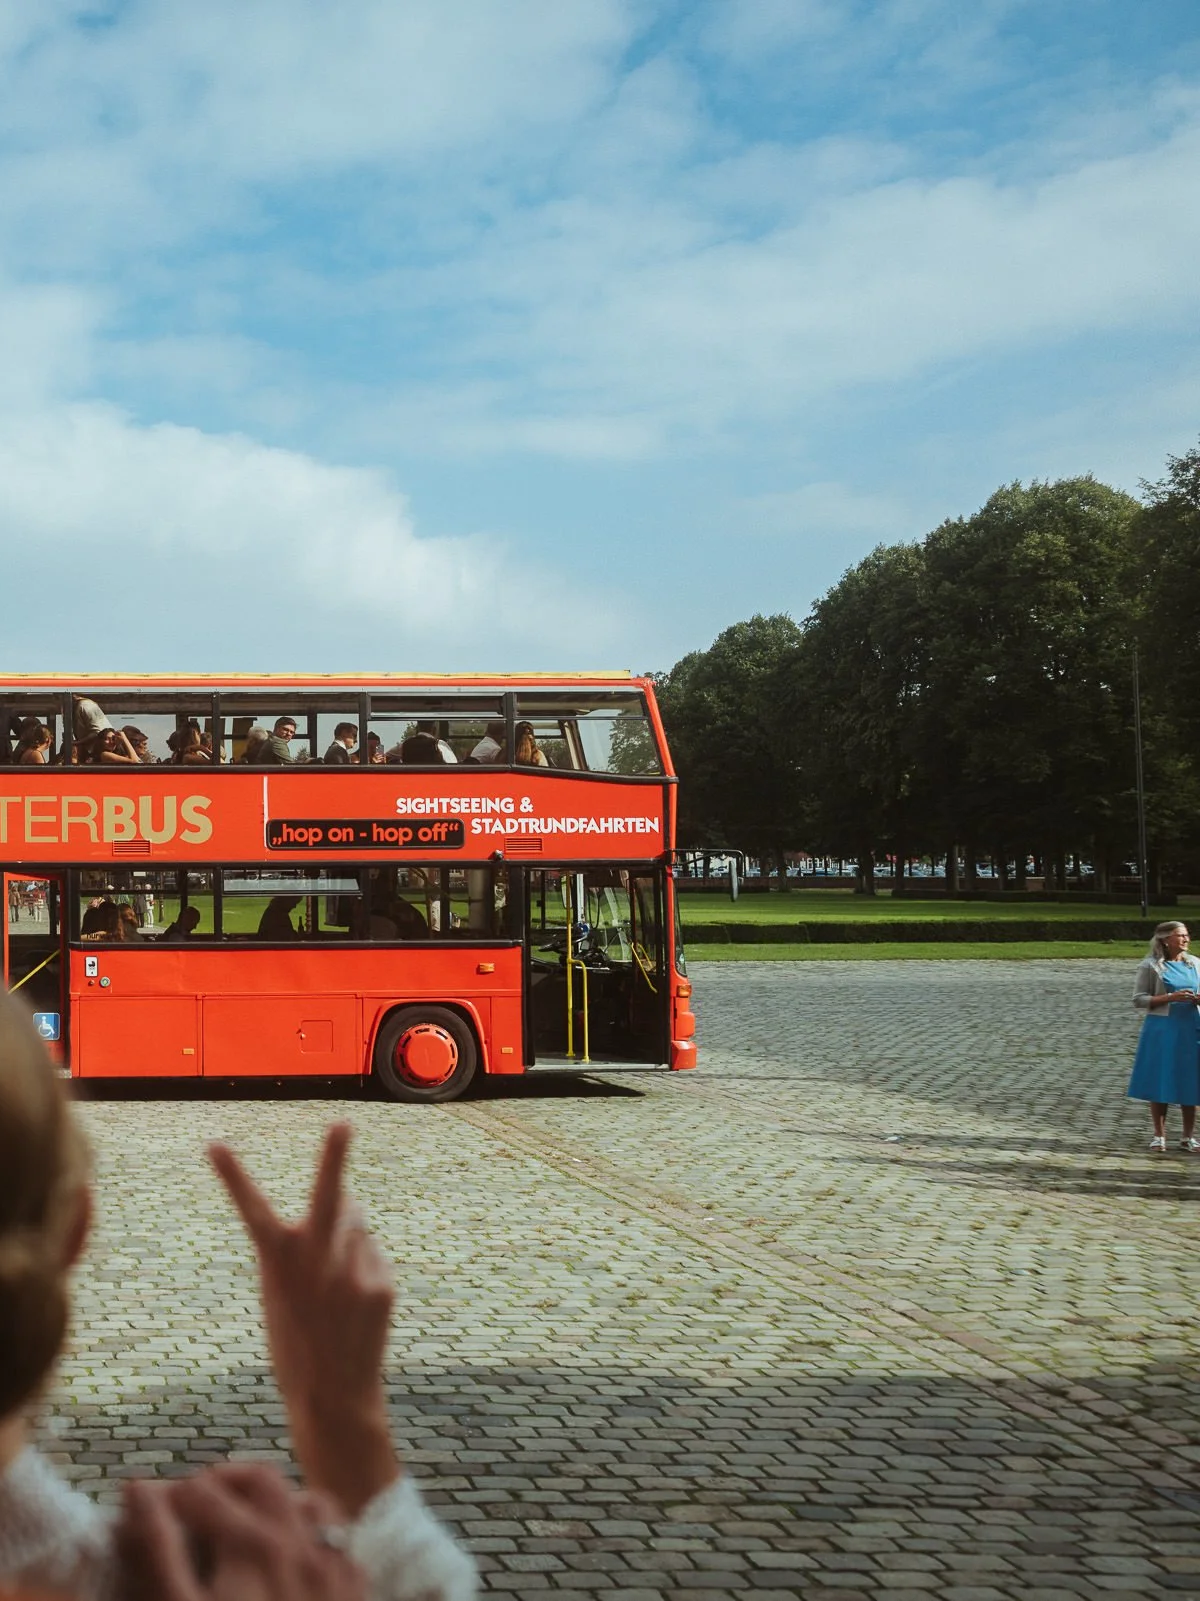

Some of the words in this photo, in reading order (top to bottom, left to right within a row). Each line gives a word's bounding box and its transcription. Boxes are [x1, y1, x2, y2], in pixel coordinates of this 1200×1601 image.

[395, 796, 514, 815] SIGHTSEEING
[519, 796, 534, 813] &
[327, 827, 355, 843] on
[372, 822, 414, 847] hop
[470, 816, 660, 835] STADTRUNDFAHRTEN
